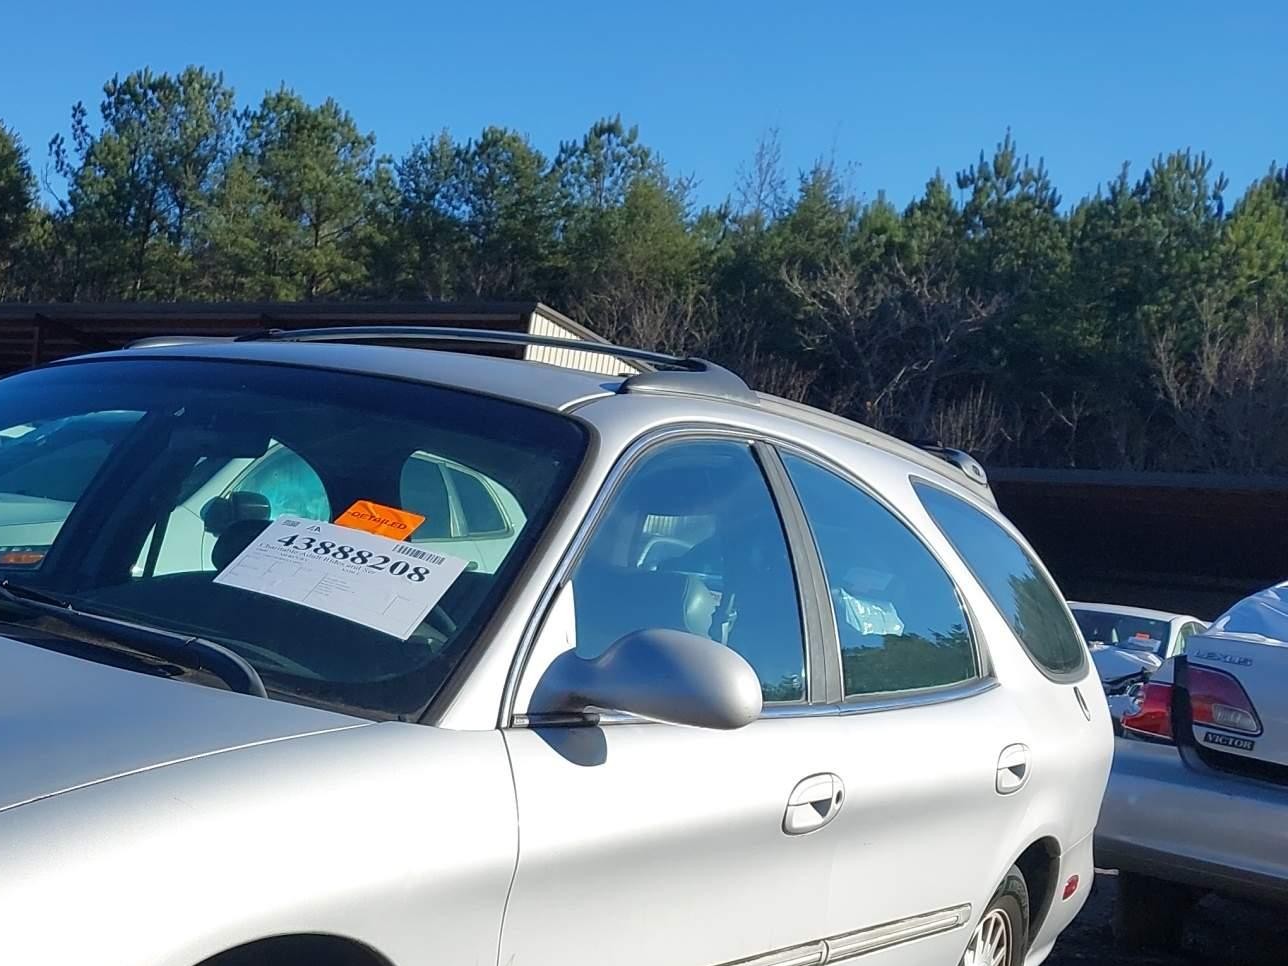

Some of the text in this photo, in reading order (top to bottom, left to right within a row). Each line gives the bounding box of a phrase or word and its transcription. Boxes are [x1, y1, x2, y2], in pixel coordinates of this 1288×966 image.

[351, 511, 407, 530] DETAILED
[277, 534, 431, 583] 43888208
[1194, 650, 1253, 666] LEXUS
[1206, 733, 1253, 750] VICTOR
